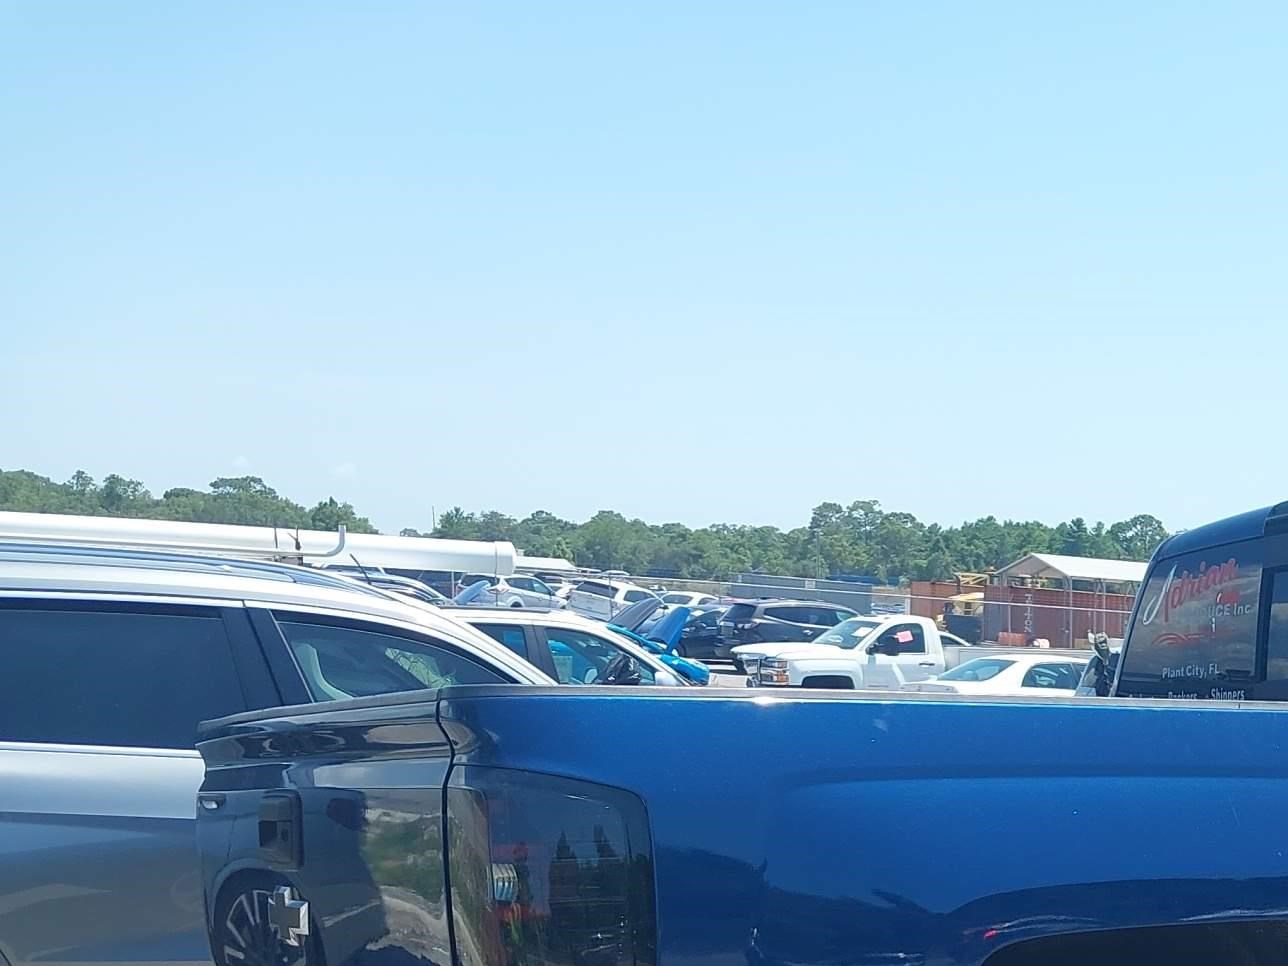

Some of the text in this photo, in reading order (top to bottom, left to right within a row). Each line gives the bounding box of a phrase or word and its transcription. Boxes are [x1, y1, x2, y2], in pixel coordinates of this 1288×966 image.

[1162, 663, 1220, 679] Plant City, FL
